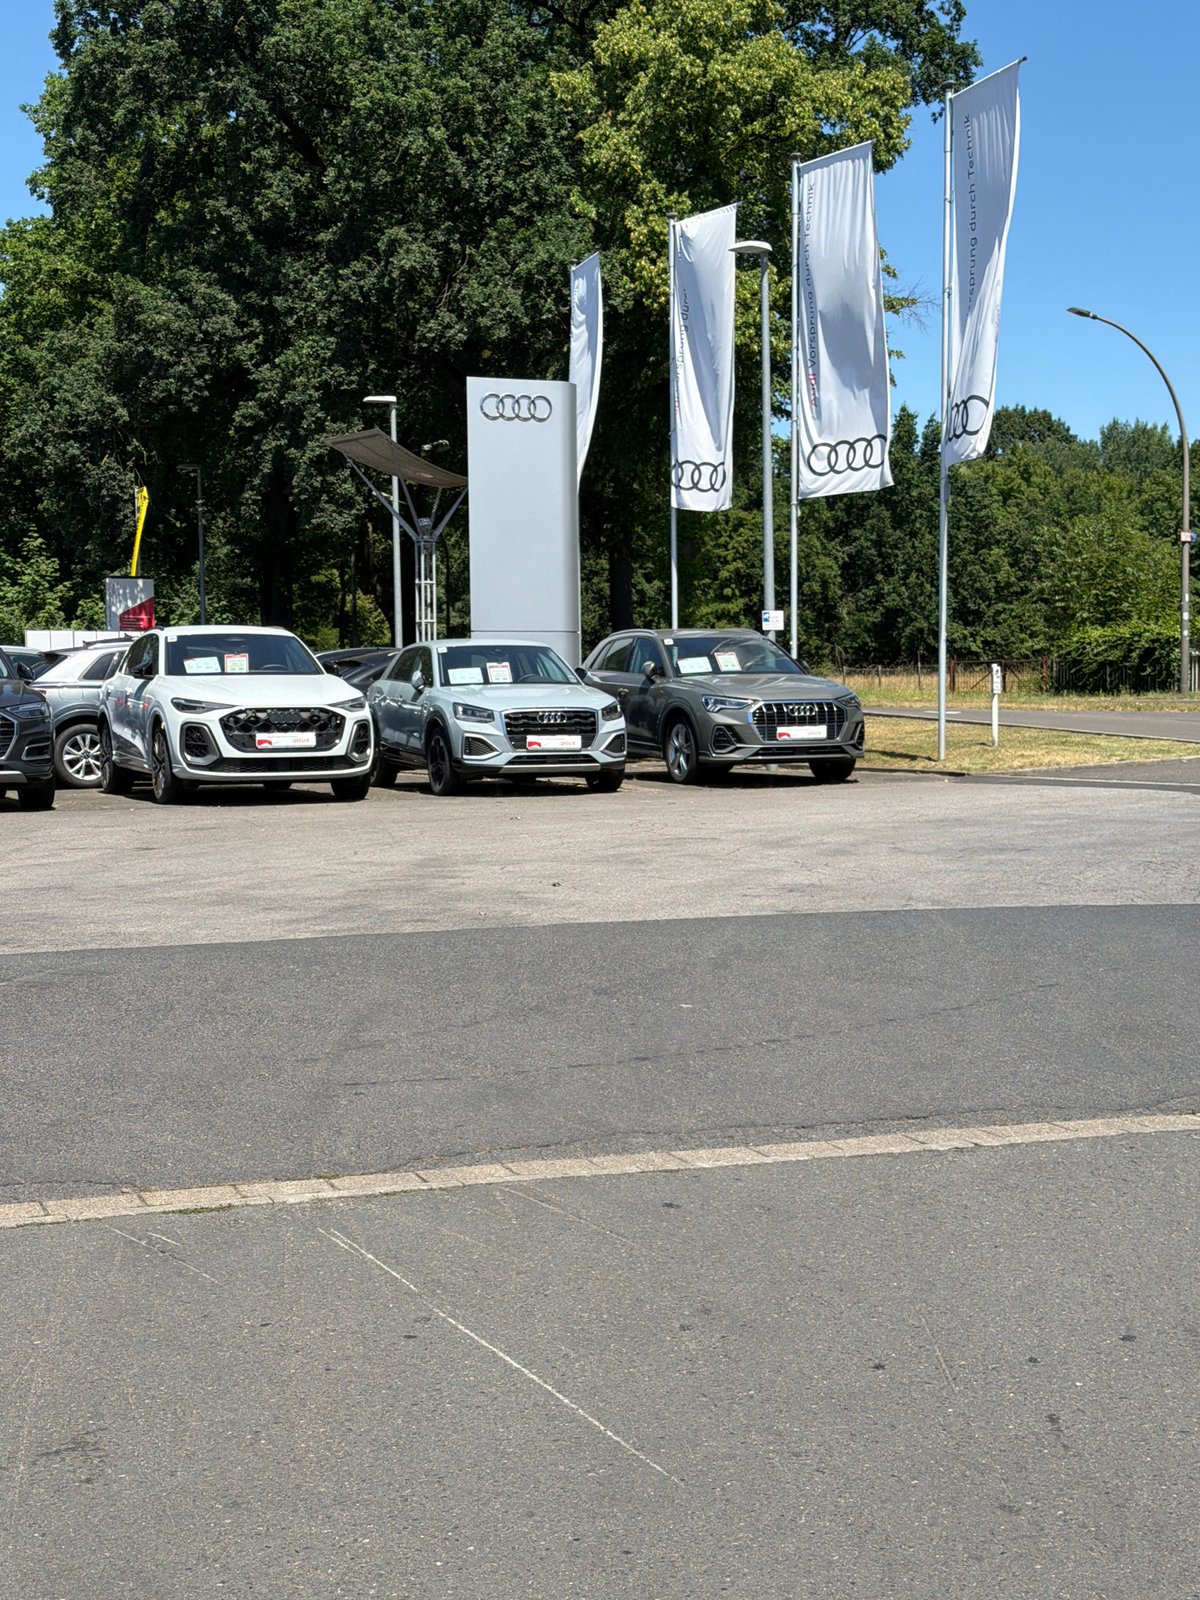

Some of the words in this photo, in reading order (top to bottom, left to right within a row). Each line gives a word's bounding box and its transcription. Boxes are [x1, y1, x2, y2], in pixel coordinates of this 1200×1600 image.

[963, 112, 975, 179] Technik
[804, 182, 815, 240] Technik
[968, 183, 977, 232] durch
[803, 242, 811, 287] durch
[807, 291, 816, 369] Vorsprung
[808, 372, 818, 408] Audi
